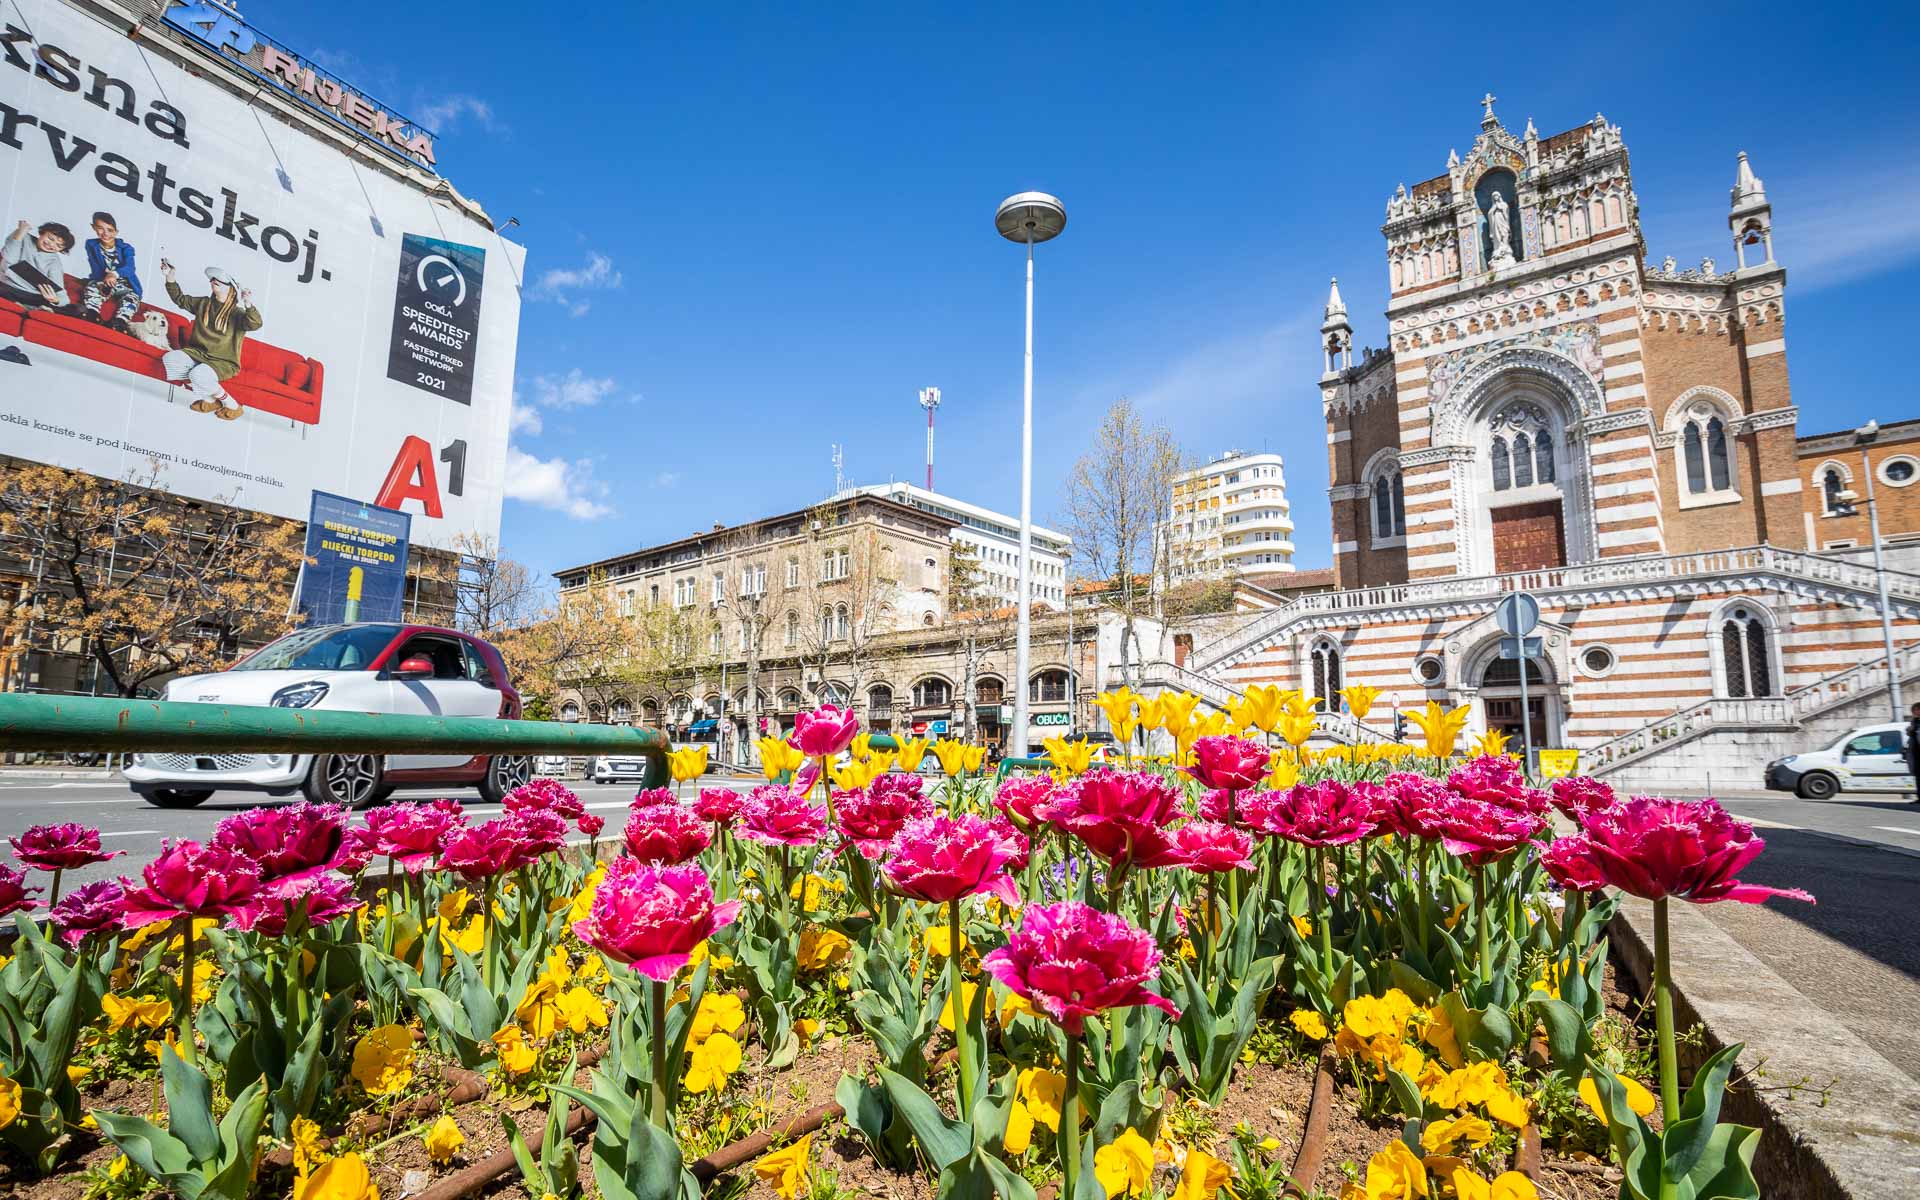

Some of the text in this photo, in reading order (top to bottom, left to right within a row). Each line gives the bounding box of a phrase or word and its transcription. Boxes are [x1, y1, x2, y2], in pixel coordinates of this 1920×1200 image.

[263, 45, 437, 164] RIJEKA
[402, 306, 471, 341] SPEEDTEST
[408, 322, 463, 350] AWARDS
[403, 340, 463, 368] FASTEST FIXED
[412, 352, 454, 373] NETWORK
[417, 372, 446, 391] 2021
[33, 419, 76, 438] koriste
[79, 433, 93, 442] se
[96, 437, 120, 448] pod
[122, 442, 171, 460] licencom
[191, 459, 252, 480] dozvoljenom
[373, 434, 467, 518] A1
[362, 529, 397, 544] TORPEDO
[322, 540, 395, 562] RIJEČKI TORPEDO
